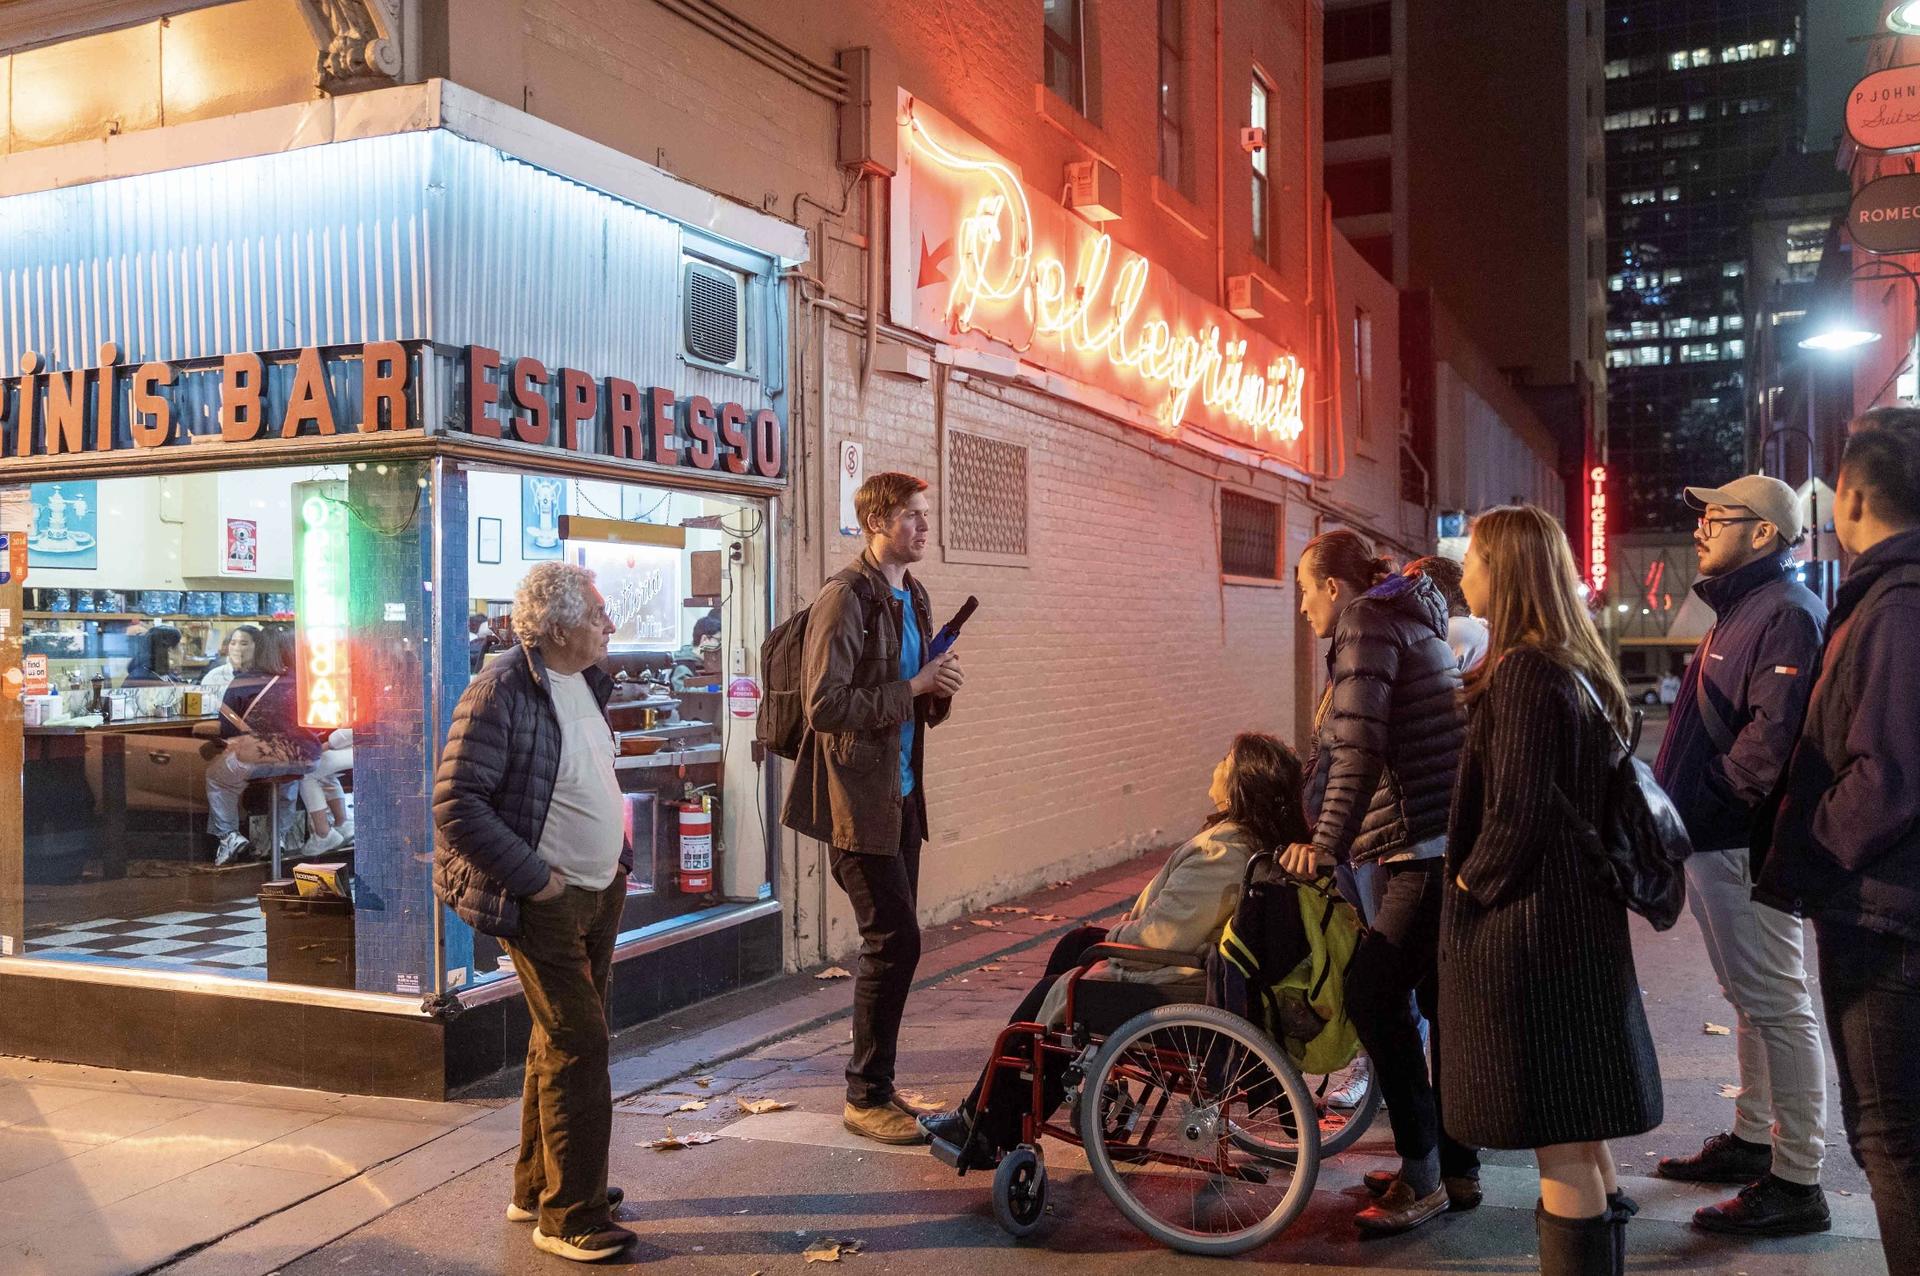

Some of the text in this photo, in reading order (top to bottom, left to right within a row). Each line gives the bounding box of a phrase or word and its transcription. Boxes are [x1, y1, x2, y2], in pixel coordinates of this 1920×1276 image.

[1870, 84, 1920, 103] JOHN
[222, 341, 411, 441] BAR
[465, 345, 782, 478] ESPRESSO
[1591, 467, 1607, 591] GINGERBOY
